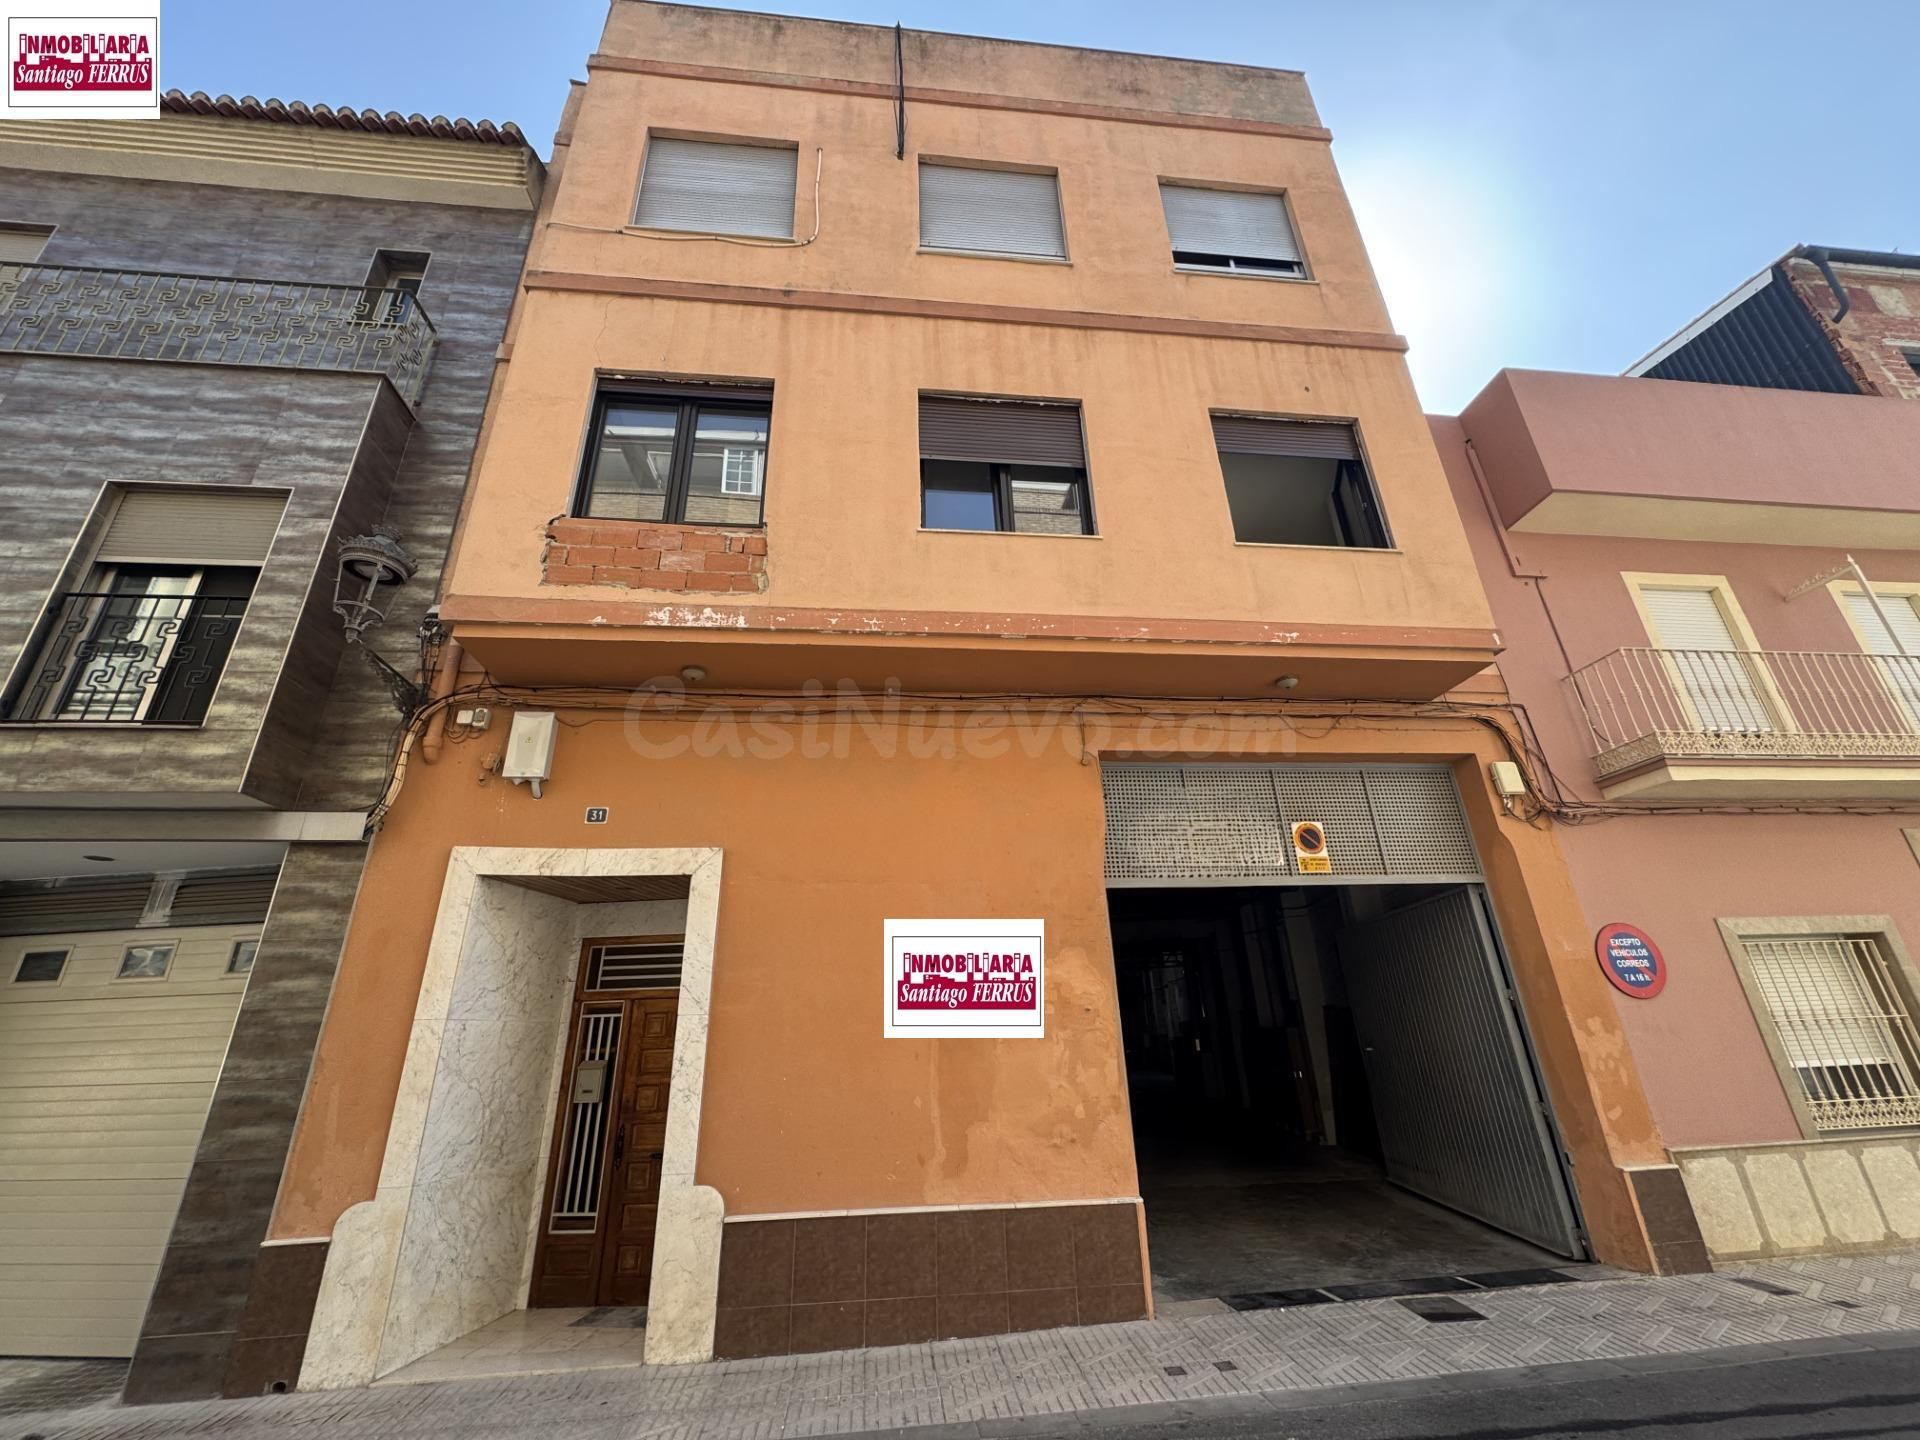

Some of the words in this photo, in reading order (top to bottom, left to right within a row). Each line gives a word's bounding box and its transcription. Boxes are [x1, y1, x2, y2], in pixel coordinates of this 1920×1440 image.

[590, 810, 603, 820] 31
[1610, 938, 1641, 946] EXCEPTO
[1616, 959, 1650, 968] CORREOS
